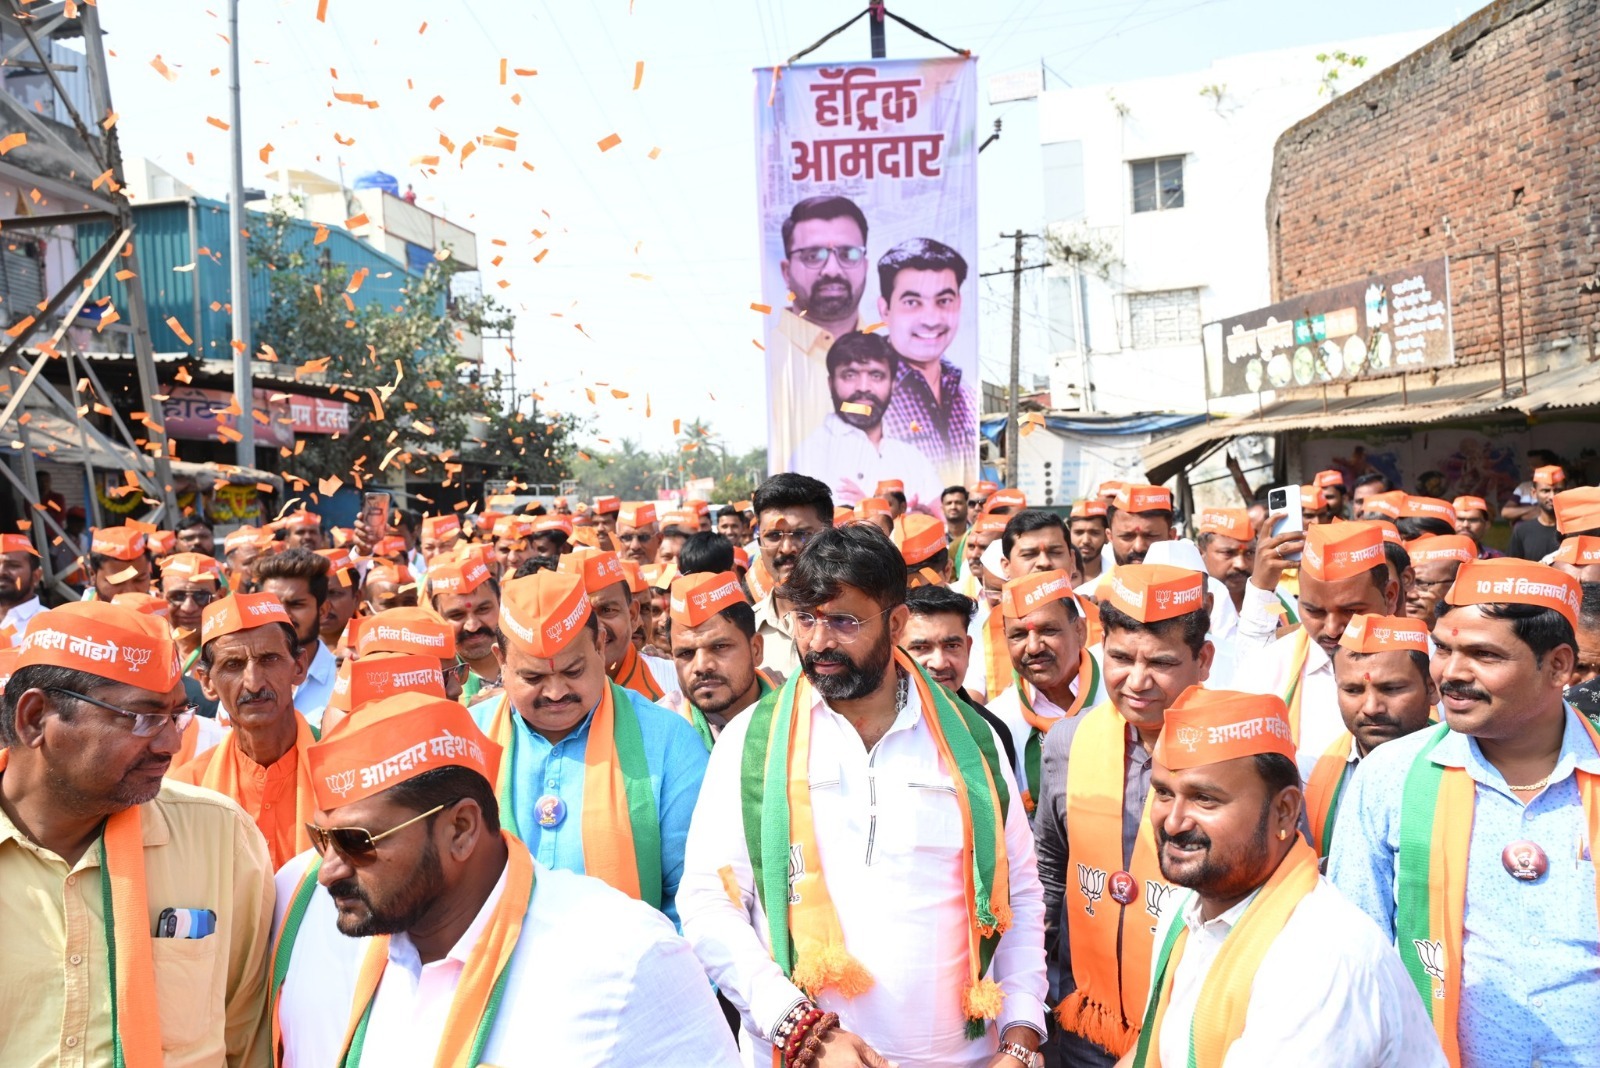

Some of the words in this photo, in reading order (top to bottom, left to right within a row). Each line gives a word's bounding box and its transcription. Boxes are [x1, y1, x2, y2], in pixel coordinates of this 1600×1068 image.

[810, 67, 921, 131] हॅट्रिक
[791, 134, 944, 182] आमदार
[1350, 543, 1379, 562] आमदार
[1173, 585, 1202, 605] आमदार
[1476, 580, 1491, 594] 10
[1493, 578, 1513, 595] वर्षे
[247, 605, 259, 616] 10
[34, 628, 67, 650] महेश
[68, 635, 119, 663] लांडगे
[391, 668, 433, 688] आमदार
[1207, 717, 1263, 744] आमदार
[359, 741, 428, 789] आमदार
[429, 729, 467, 759] महेश
